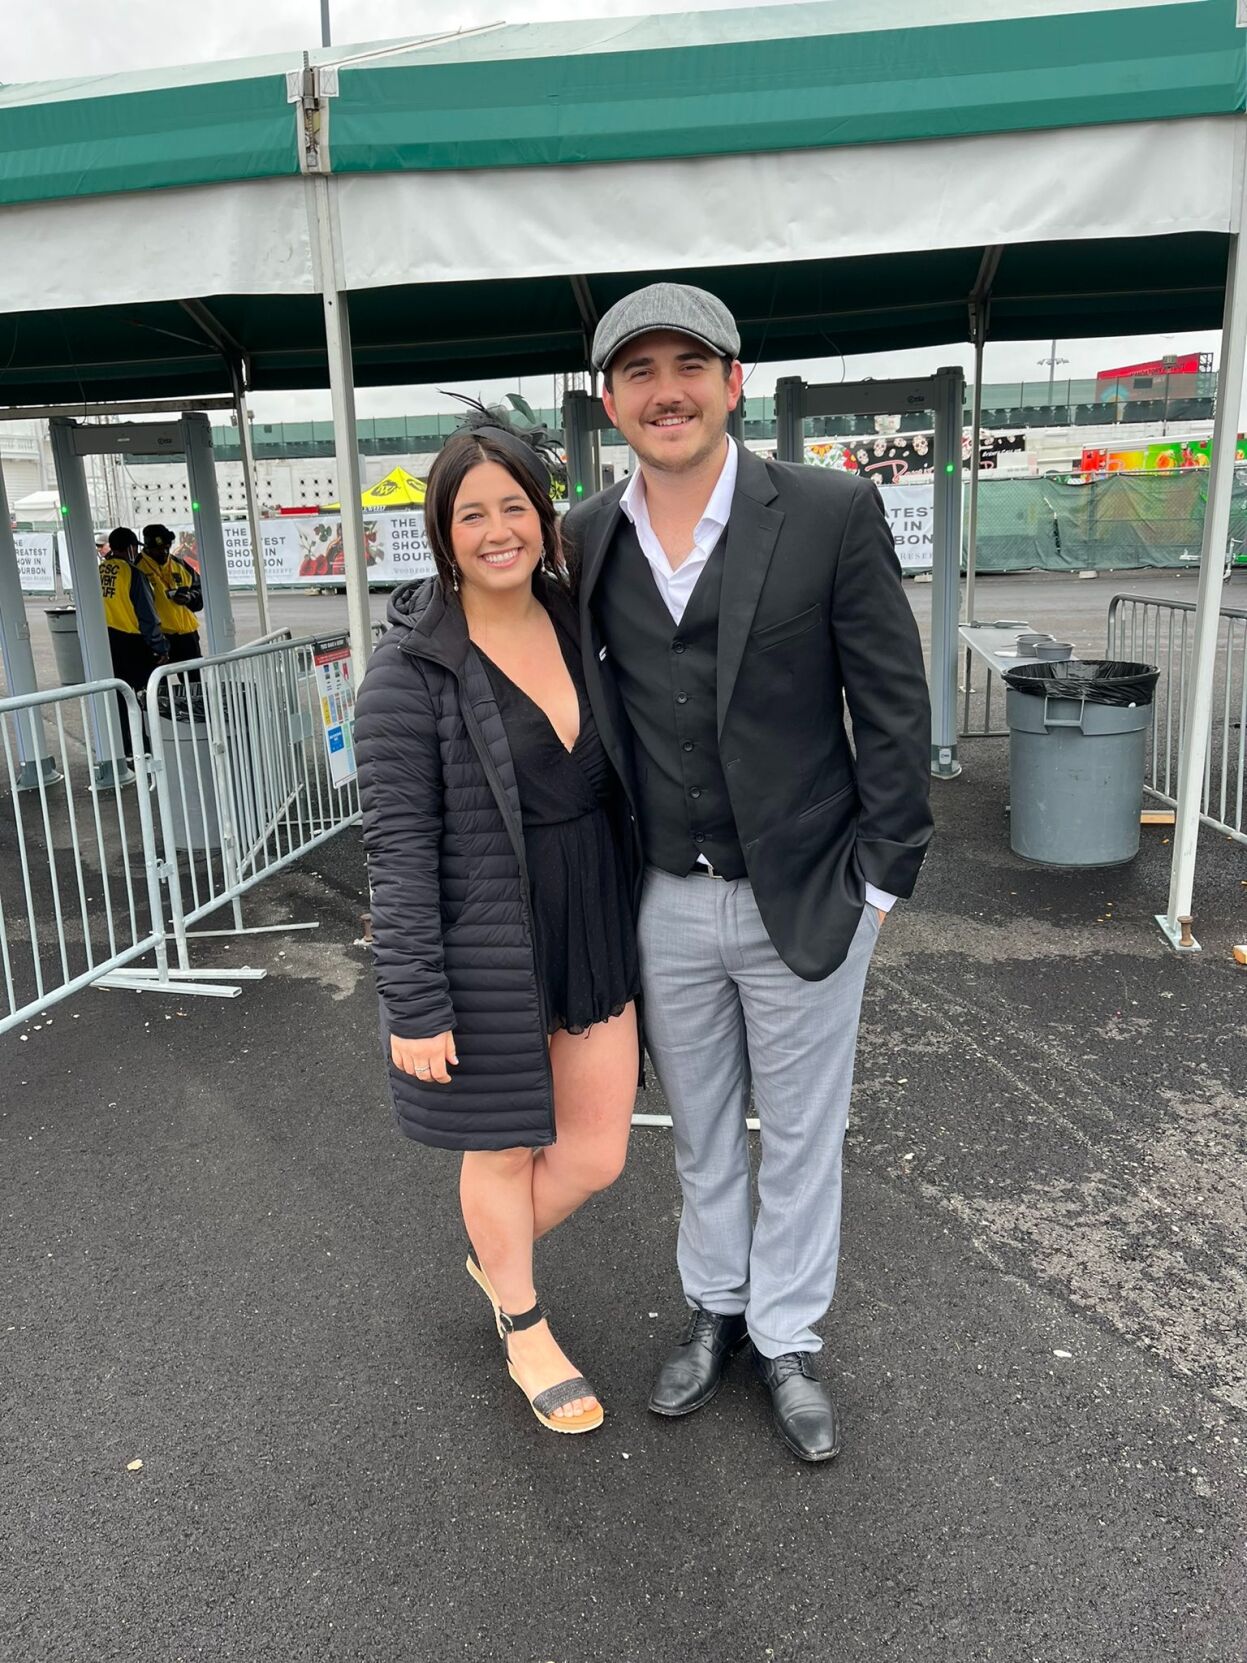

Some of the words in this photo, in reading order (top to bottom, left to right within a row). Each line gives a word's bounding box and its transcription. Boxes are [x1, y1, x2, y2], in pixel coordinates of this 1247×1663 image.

[391, 518, 417, 528] THE
[903, 520, 922, 532] IN
[224, 528, 247, 537] THE
[391, 529, 427, 539] GREA
[226, 536, 286, 548] GREEST
[16, 548, 47, 557] REATEST
[226, 548, 253, 558] SHO
[265, 547, 277, 556] IN
[392, 552, 432, 562] BOUR
[227, 558, 283, 568] BOUON
[20, 567, 46, 575] URBON
[99, 563, 120, 575] CSC
[100, 574, 117, 587] VENT
